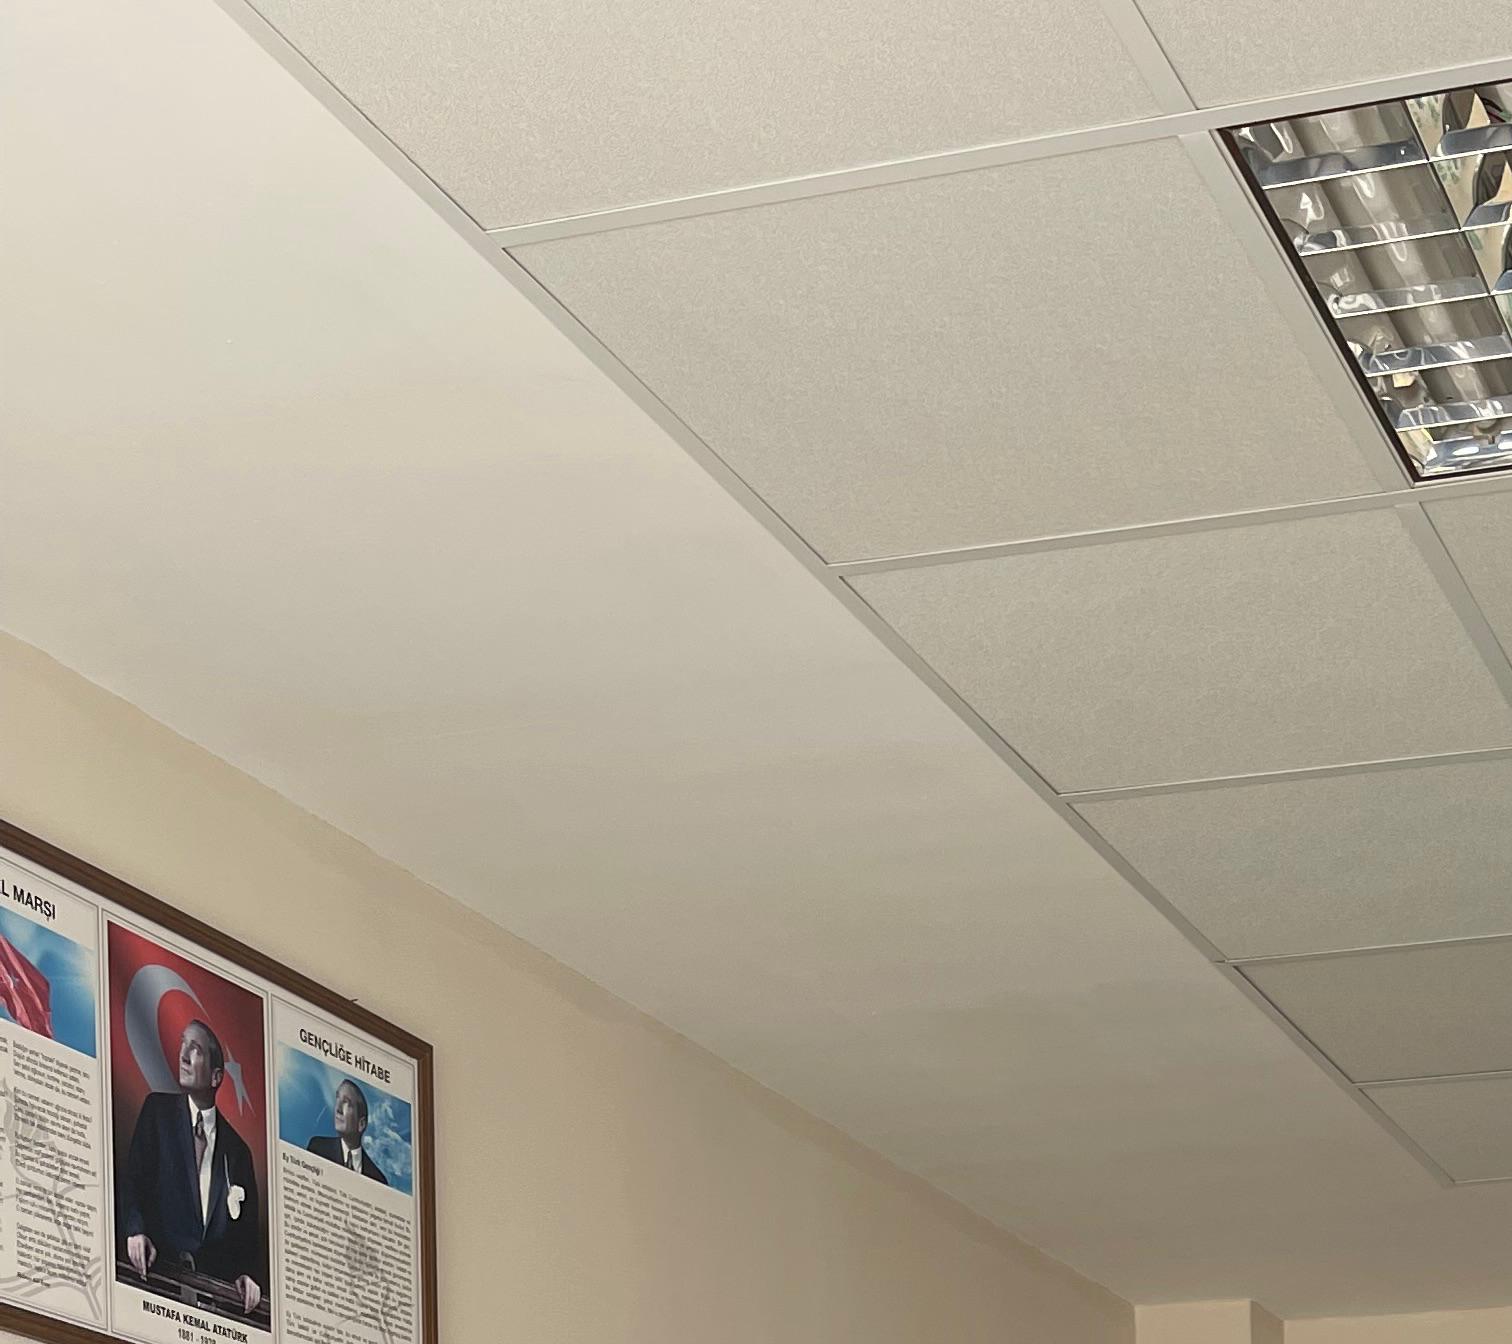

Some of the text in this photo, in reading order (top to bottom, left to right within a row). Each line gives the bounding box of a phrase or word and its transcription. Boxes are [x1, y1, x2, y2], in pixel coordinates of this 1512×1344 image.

[0, 879, 56, 922] L MARŞI
[300, 1028, 391, 1084] GENÇLİĞE HİTABE
[143, 1300, 248, 1344] MUSTAFA KEMAL ATATÜRK
[178, 1328, 194, 1342] 1881
